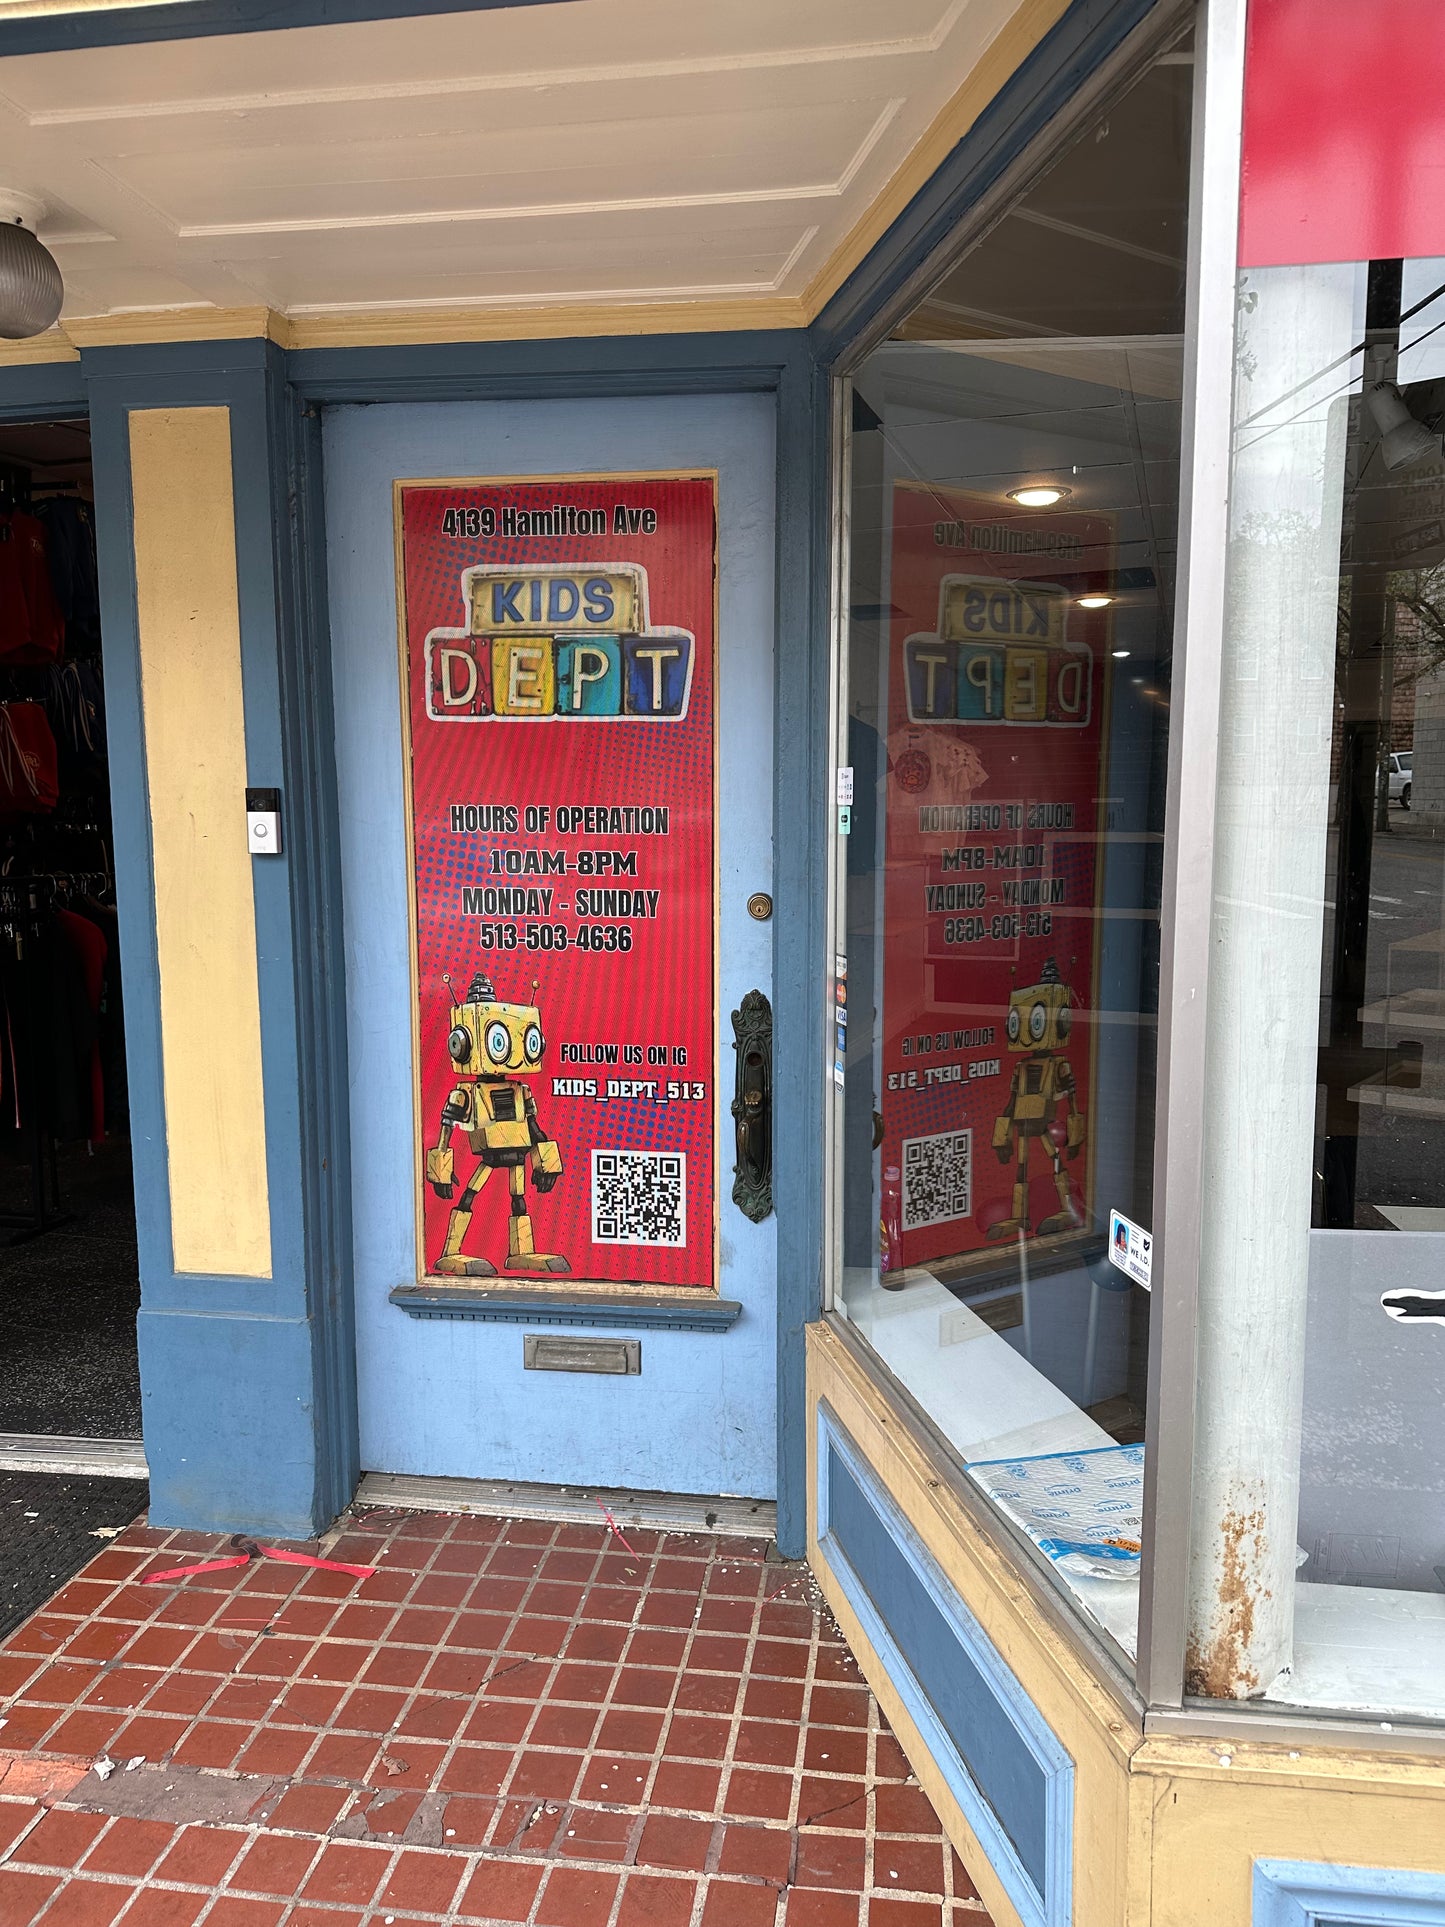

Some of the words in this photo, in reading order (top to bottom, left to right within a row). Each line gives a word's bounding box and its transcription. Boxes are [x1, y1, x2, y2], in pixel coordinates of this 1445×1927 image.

[441, 507, 496, 537] 4139
[501, 505, 607, 537] Hamilton
[613, 504, 657, 535] Ave
[491, 578, 614, 624] KIDS
[440, 646, 680, 711] DEPT
[450, 804, 518, 834] HOURS
[525, 805, 550, 834] OF
[556, 806, 670, 835] OPERATION
[490, 849, 638, 876] 10AM-8PM
[461, 887, 554, 917] MONDAY
[576, 889, 661, 918] SUNDAY
[480, 922, 633, 953] 513-503-4636
[560, 1043, 618, 1064] FOLLOW
[623, 1045, 643, 1065] US
[647, 1046, 667, 1066] ON
[672, 1046, 687, 1066] IG
[551, 1078, 705, 1104] KIDS_DEPT_513
[1131, 1246, 1139, 1258] WE
[1108, 1478, 1141, 1488] prime
[1099, 1502, 1132, 1513] prime
[1087, 1526, 1121, 1537] prime
